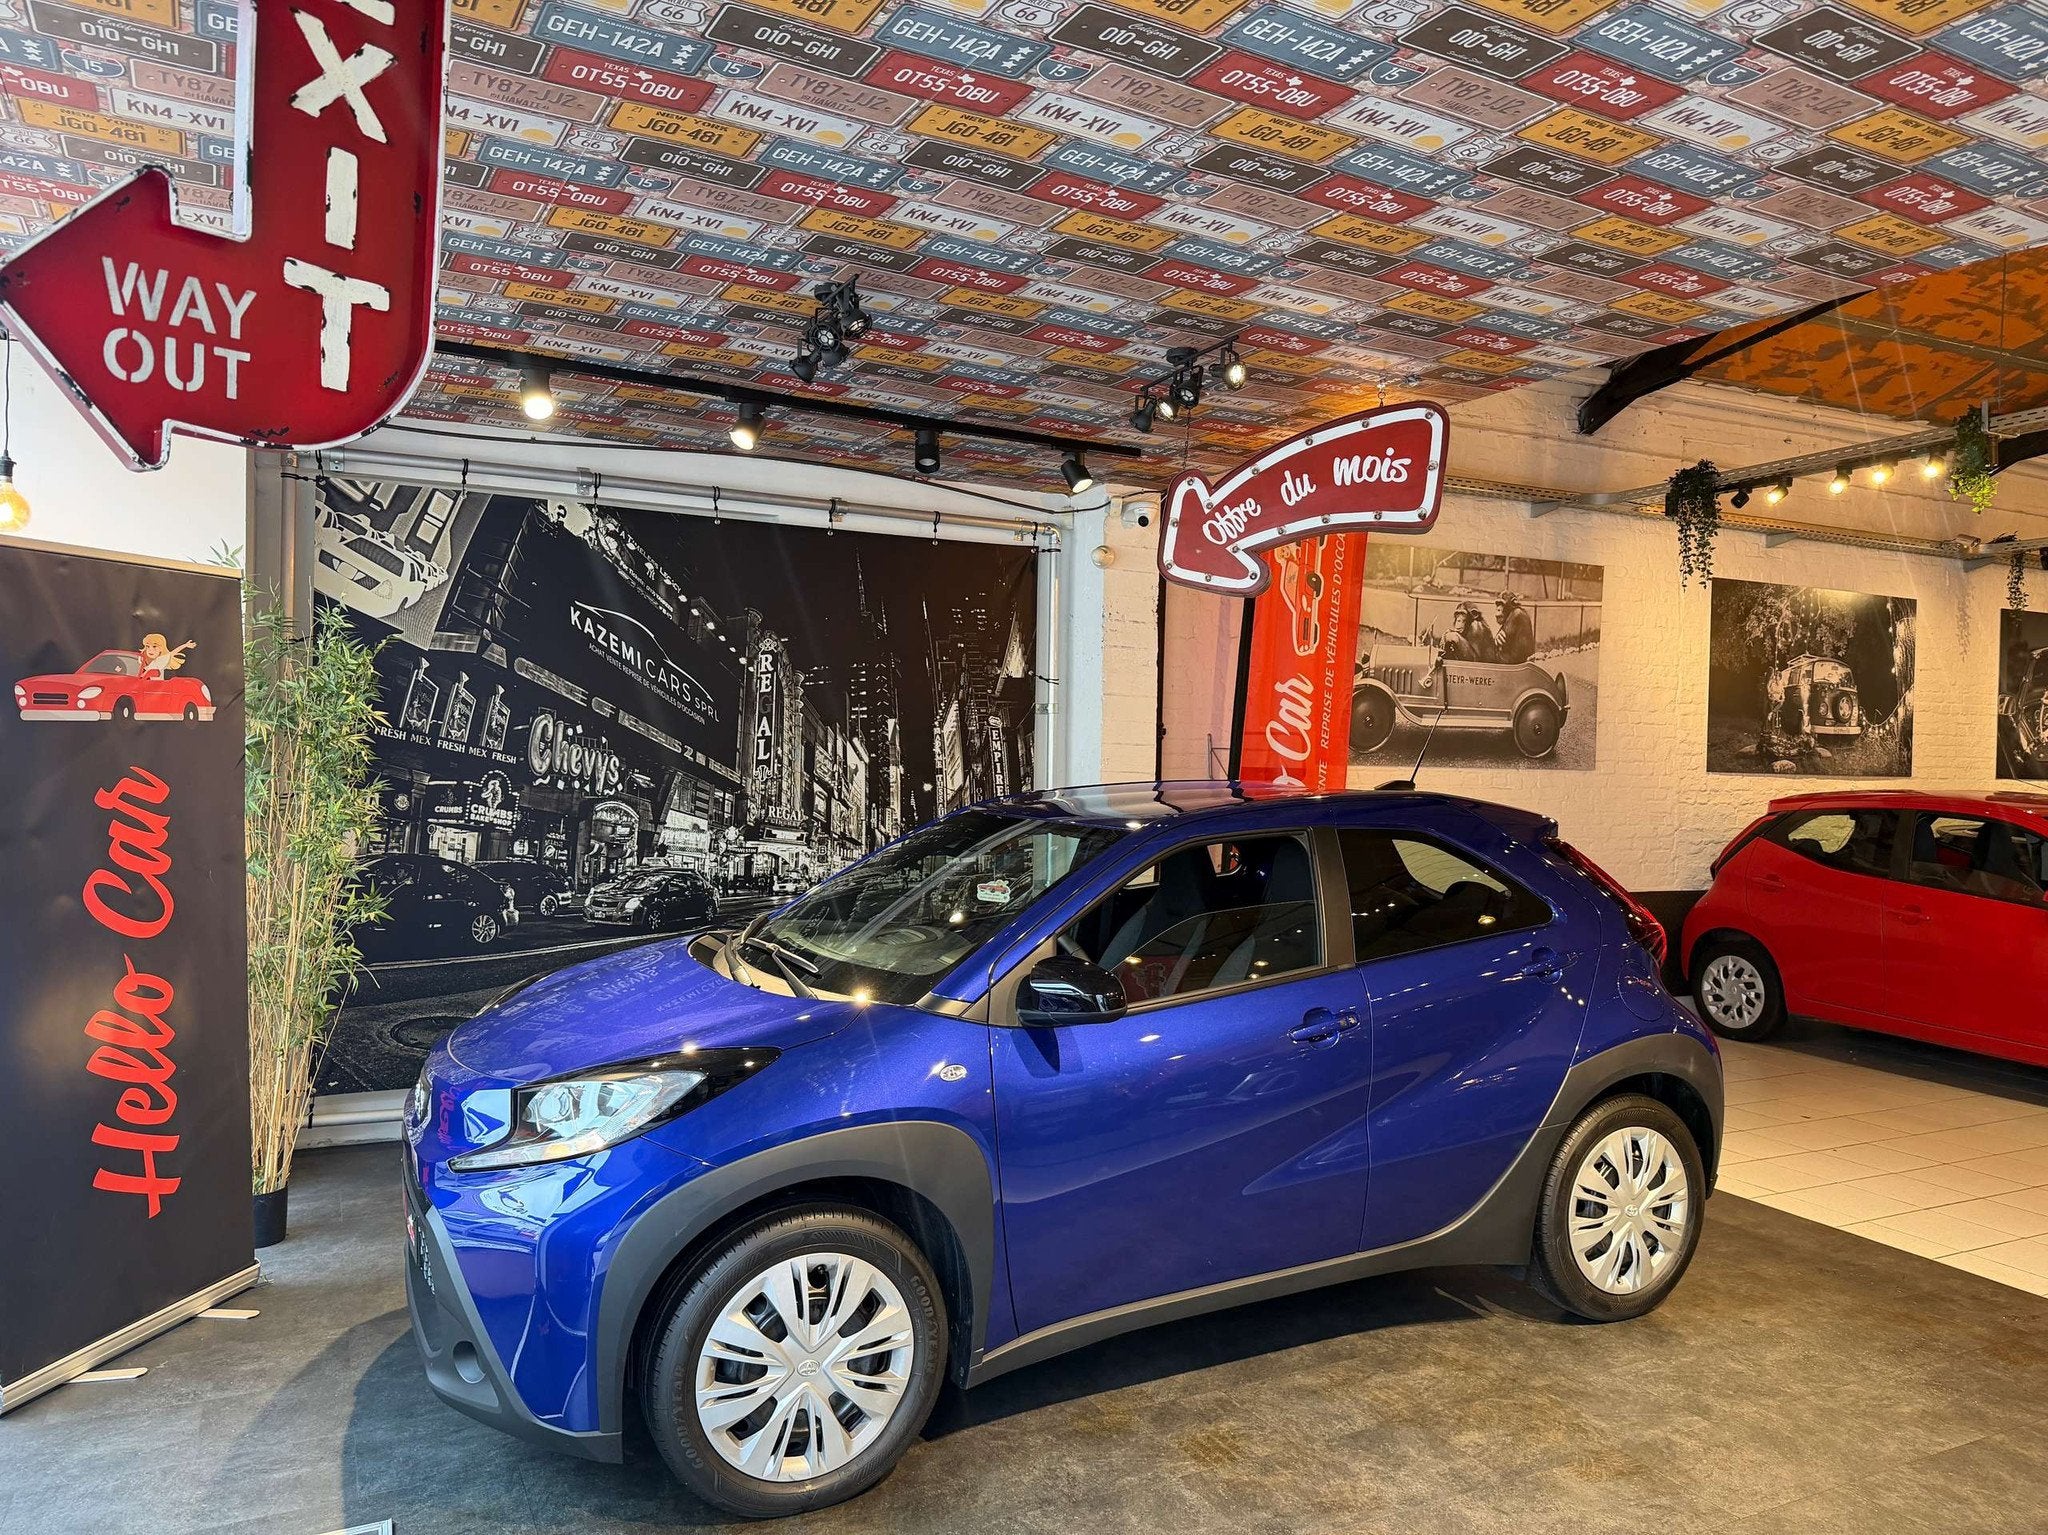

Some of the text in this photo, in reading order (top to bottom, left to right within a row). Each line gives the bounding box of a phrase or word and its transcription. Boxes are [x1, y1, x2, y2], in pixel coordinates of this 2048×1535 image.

[547, 16, 664, 57] GEH-142A
[892, 19, 1002, 60] GEH-142A
[1243, 20, 1347, 61] GEH-142A
[1599, 20, 1698, 61] GEH-142A
[82, 58, 104, 73] 15
[604, 63, 630, 74] TEXAS
[724, 62, 744, 74] 15
[931, 66, 956, 76] TEXAS
[1050, 64, 1072, 76] 15
[1262, 69, 1286, 79] TEXAS
[1381, 67, 1406, 80] 15
[1599, 69, 1623, 80] TEXAS
[1718, 68, 1746, 80] 15
[728, 100, 819, 132] KN4-XV1
[1035, 102, 1122, 135] KN4-XV1
[1347, 105, 1430, 138] KN4-XV1
[1665, 105, 1743, 138] KN4-XV1
[489, 147, 586, 175] GEH-142A
[772, 149, 865, 177] GEH-142A
[1059, 152, 1148, 180] GEH-142A
[1350, 155, 1435, 183] GEH-142A
[1644, 154, 1725, 182] GEH-142A
[1941, 150, 2014, 182] GEH-142A
[283, 0, 397, 393] XIT
[101, 256, 257, 340] WAY
[102, 327, 251, 400] OUT
[1202, 447, 1412, 545] Offre du mois
[1332, 533, 1346, 583] D'OCCA
[570, 606, 720, 723] KAZEMI CARS SPRL
[1323, 667, 1335, 694] DE
[757, 653, 774, 761] REGAL
[1265, 673, 1315, 761] Car
[1320, 696, 1333, 750] REPRISE
[374, 726, 517, 765] FRESH MEX FRESH MEX FRESH
[528, 713, 620, 796] Chevys
[992, 730, 1004, 798] EMPIRE
[82, 765, 182, 1219] Hello Car
